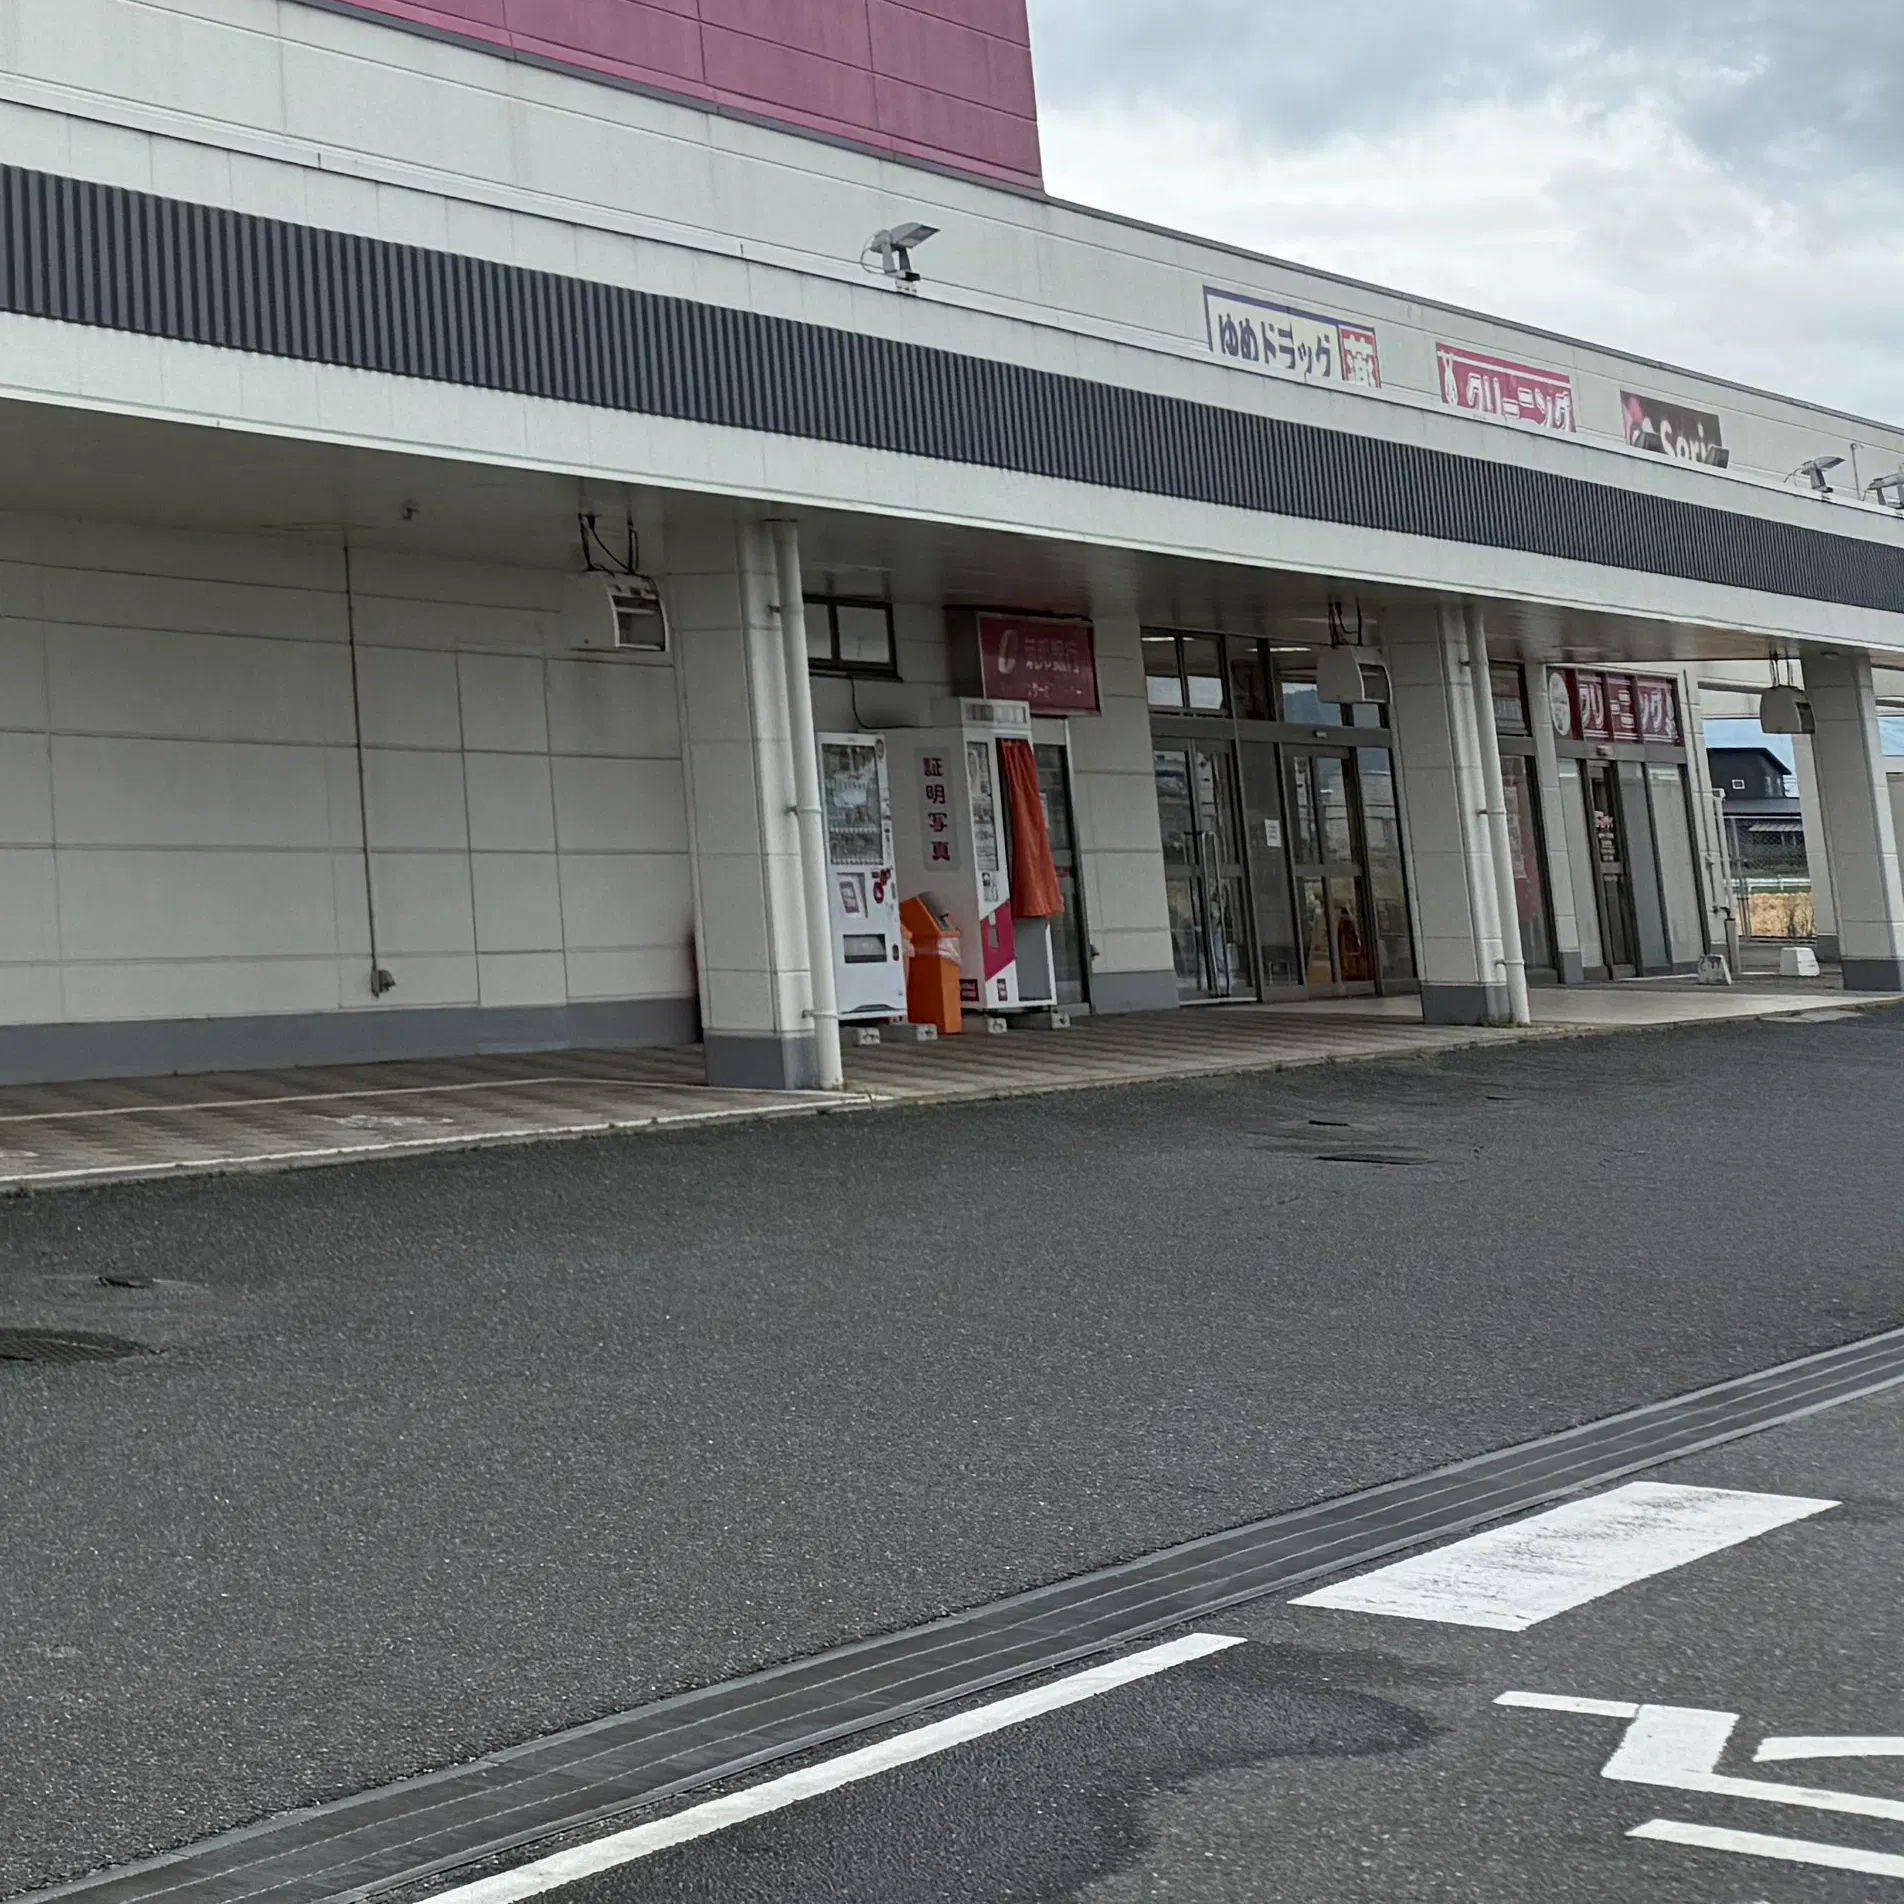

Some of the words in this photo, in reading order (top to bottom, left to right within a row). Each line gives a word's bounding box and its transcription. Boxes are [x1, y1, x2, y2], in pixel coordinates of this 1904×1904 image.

[1218, 313, 1331, 377] ゆめドラッグ
[1467, 371, 1571, 432] クリーニング
[923, 756, 951, 861] 証明写真
